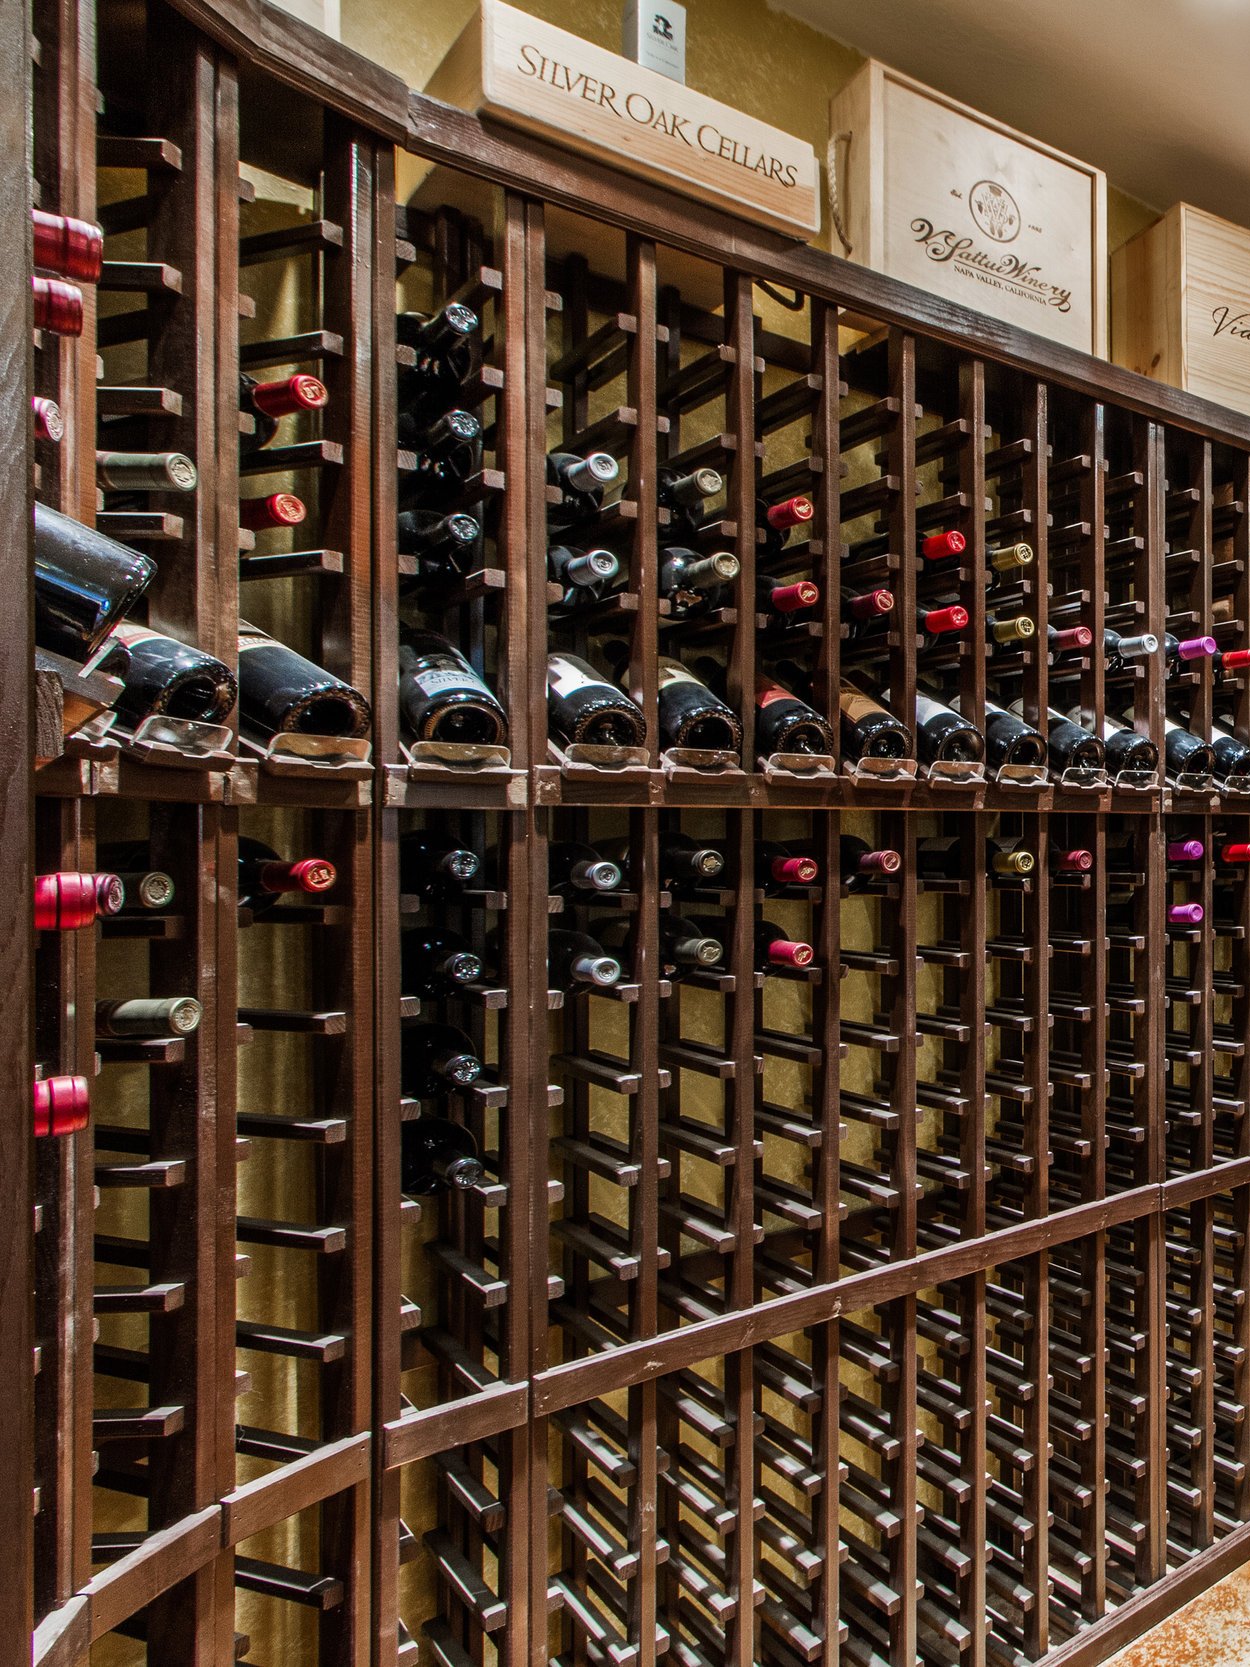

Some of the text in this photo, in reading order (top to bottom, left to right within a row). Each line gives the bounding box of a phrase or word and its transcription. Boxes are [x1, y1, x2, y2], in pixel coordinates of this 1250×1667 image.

[517, 44, 799, 189] SILVER OAK CELLARS
[953, 264, 975, 279] NAPA
[1005, 286, 1047, 306] CALIFORNIA
[1000, 254, 1072, 313] Winery
